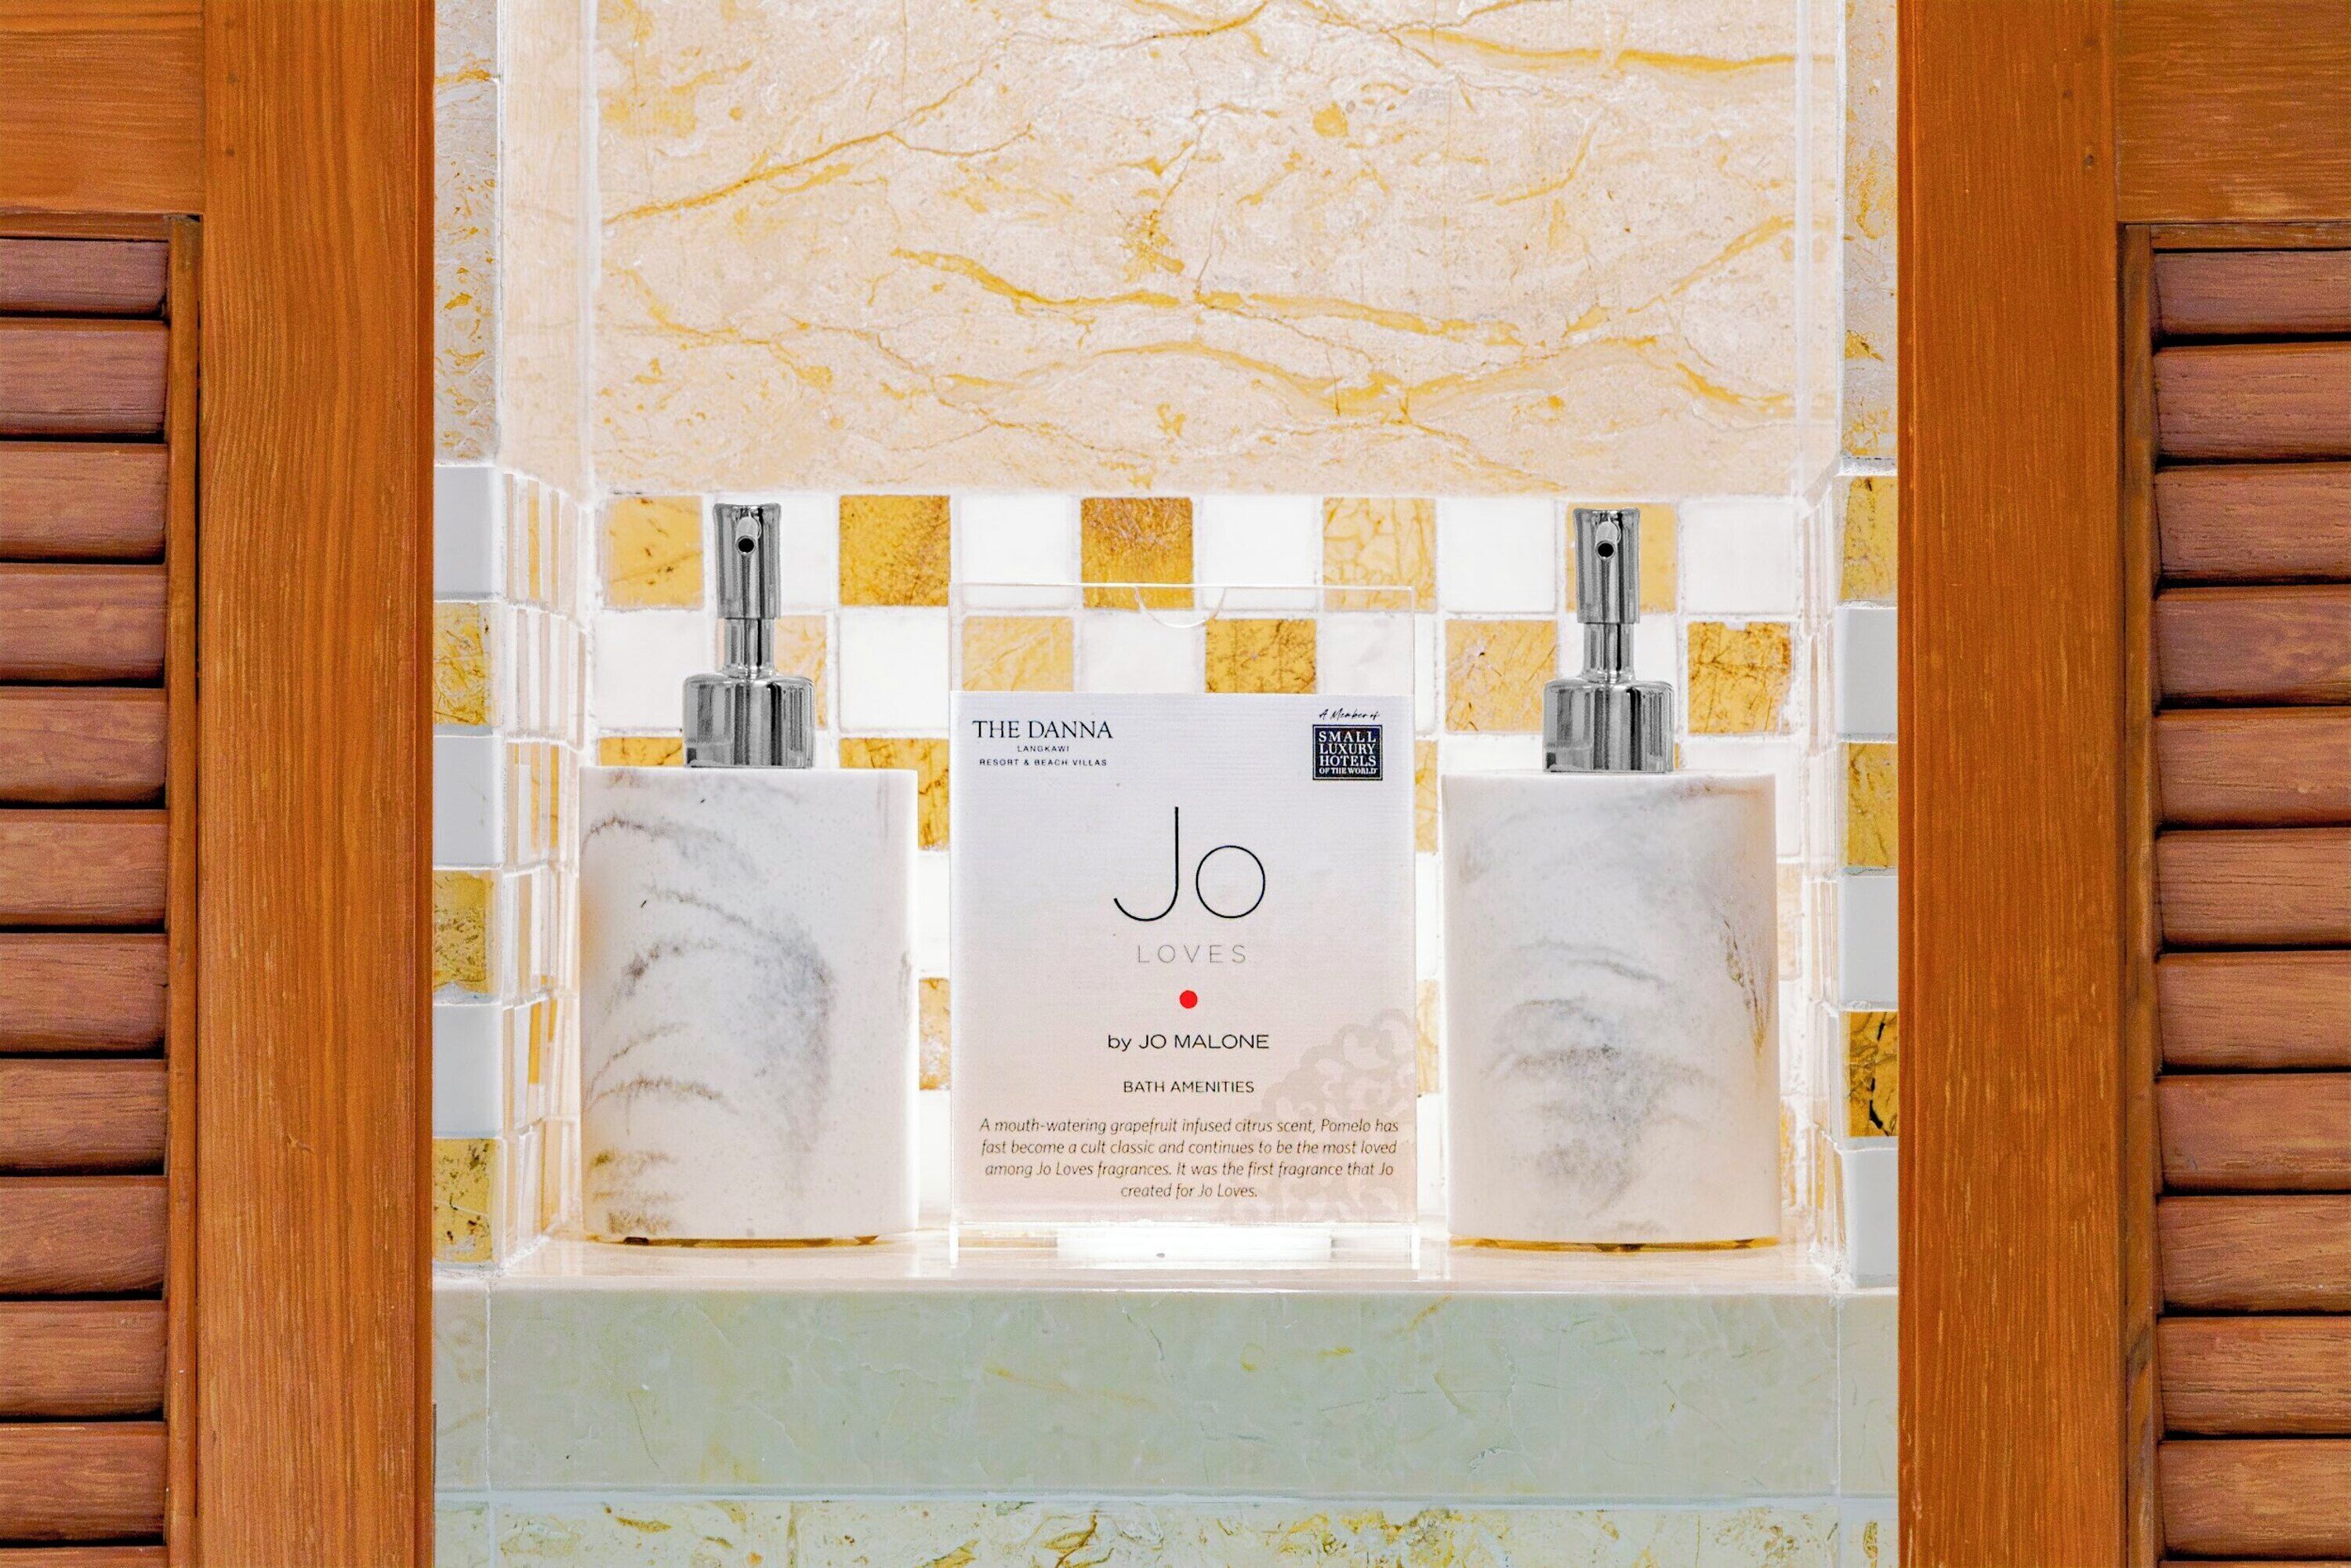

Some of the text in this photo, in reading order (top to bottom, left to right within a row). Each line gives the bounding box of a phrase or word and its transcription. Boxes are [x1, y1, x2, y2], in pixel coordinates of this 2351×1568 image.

[1319, 707, 1380, 720] A Member of
[972, 720, 1113, 739] THE DANNA
[1319, 731, 1377, 742] SMALL
[1319, 743, 1376, 754] LUXURY
[1319, 755, 1377, 767] HOTELS
[1113, 806, 1266, 922] Jo
[1137, 945, 1246, 964] LOVES
[1108, 1034, 1269, 1051] by JO MALONE
[1123, 1081, 1254, 1093] BATH AMENITIES
[980, 1118, 1399, 1135] A mouth-watering grapefruit infused citrus scent, Pomelo has
[981, 1139, 1398, 1156] fast become a cult classic and continues to be the most loved
[985, 1161, 1394, 1178] among Jo Loves fragrances. It was the first fragrance that Jo
[1120, 1183, 1258, 1200] created for Jo Loves.
